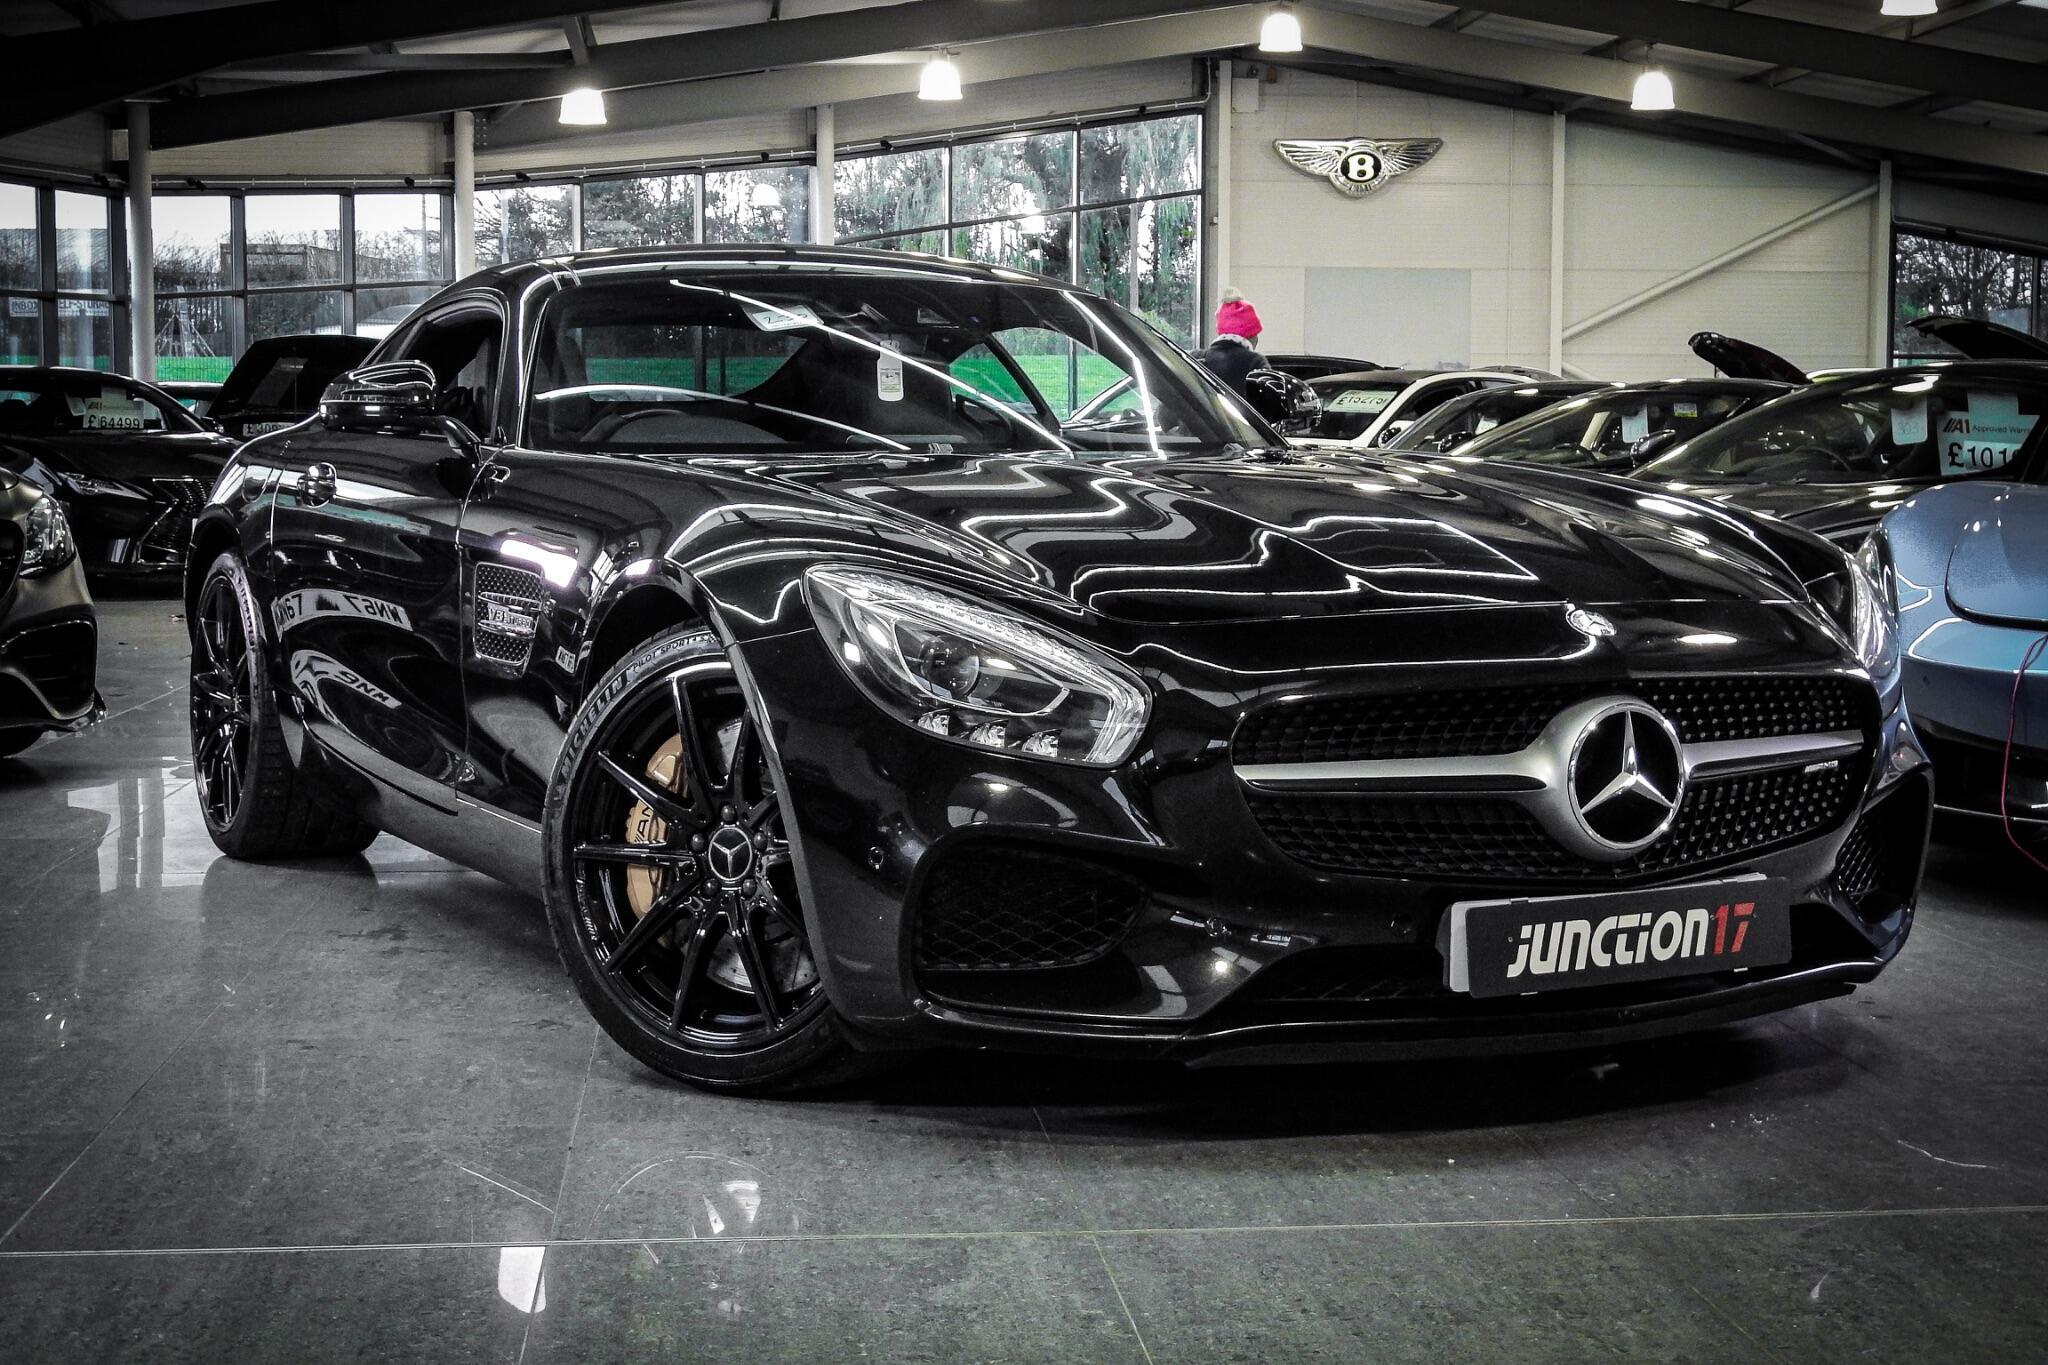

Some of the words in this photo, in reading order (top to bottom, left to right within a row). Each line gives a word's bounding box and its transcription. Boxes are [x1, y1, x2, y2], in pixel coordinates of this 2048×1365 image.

[1348, 153, 1375, 182] B
[2010, 425, 2031, 434] Warr
[559, 675, 625, 779] MICHELIN
[633, 650, 659, 673] PILOT
[660, 637, 692, 655] SPORT
